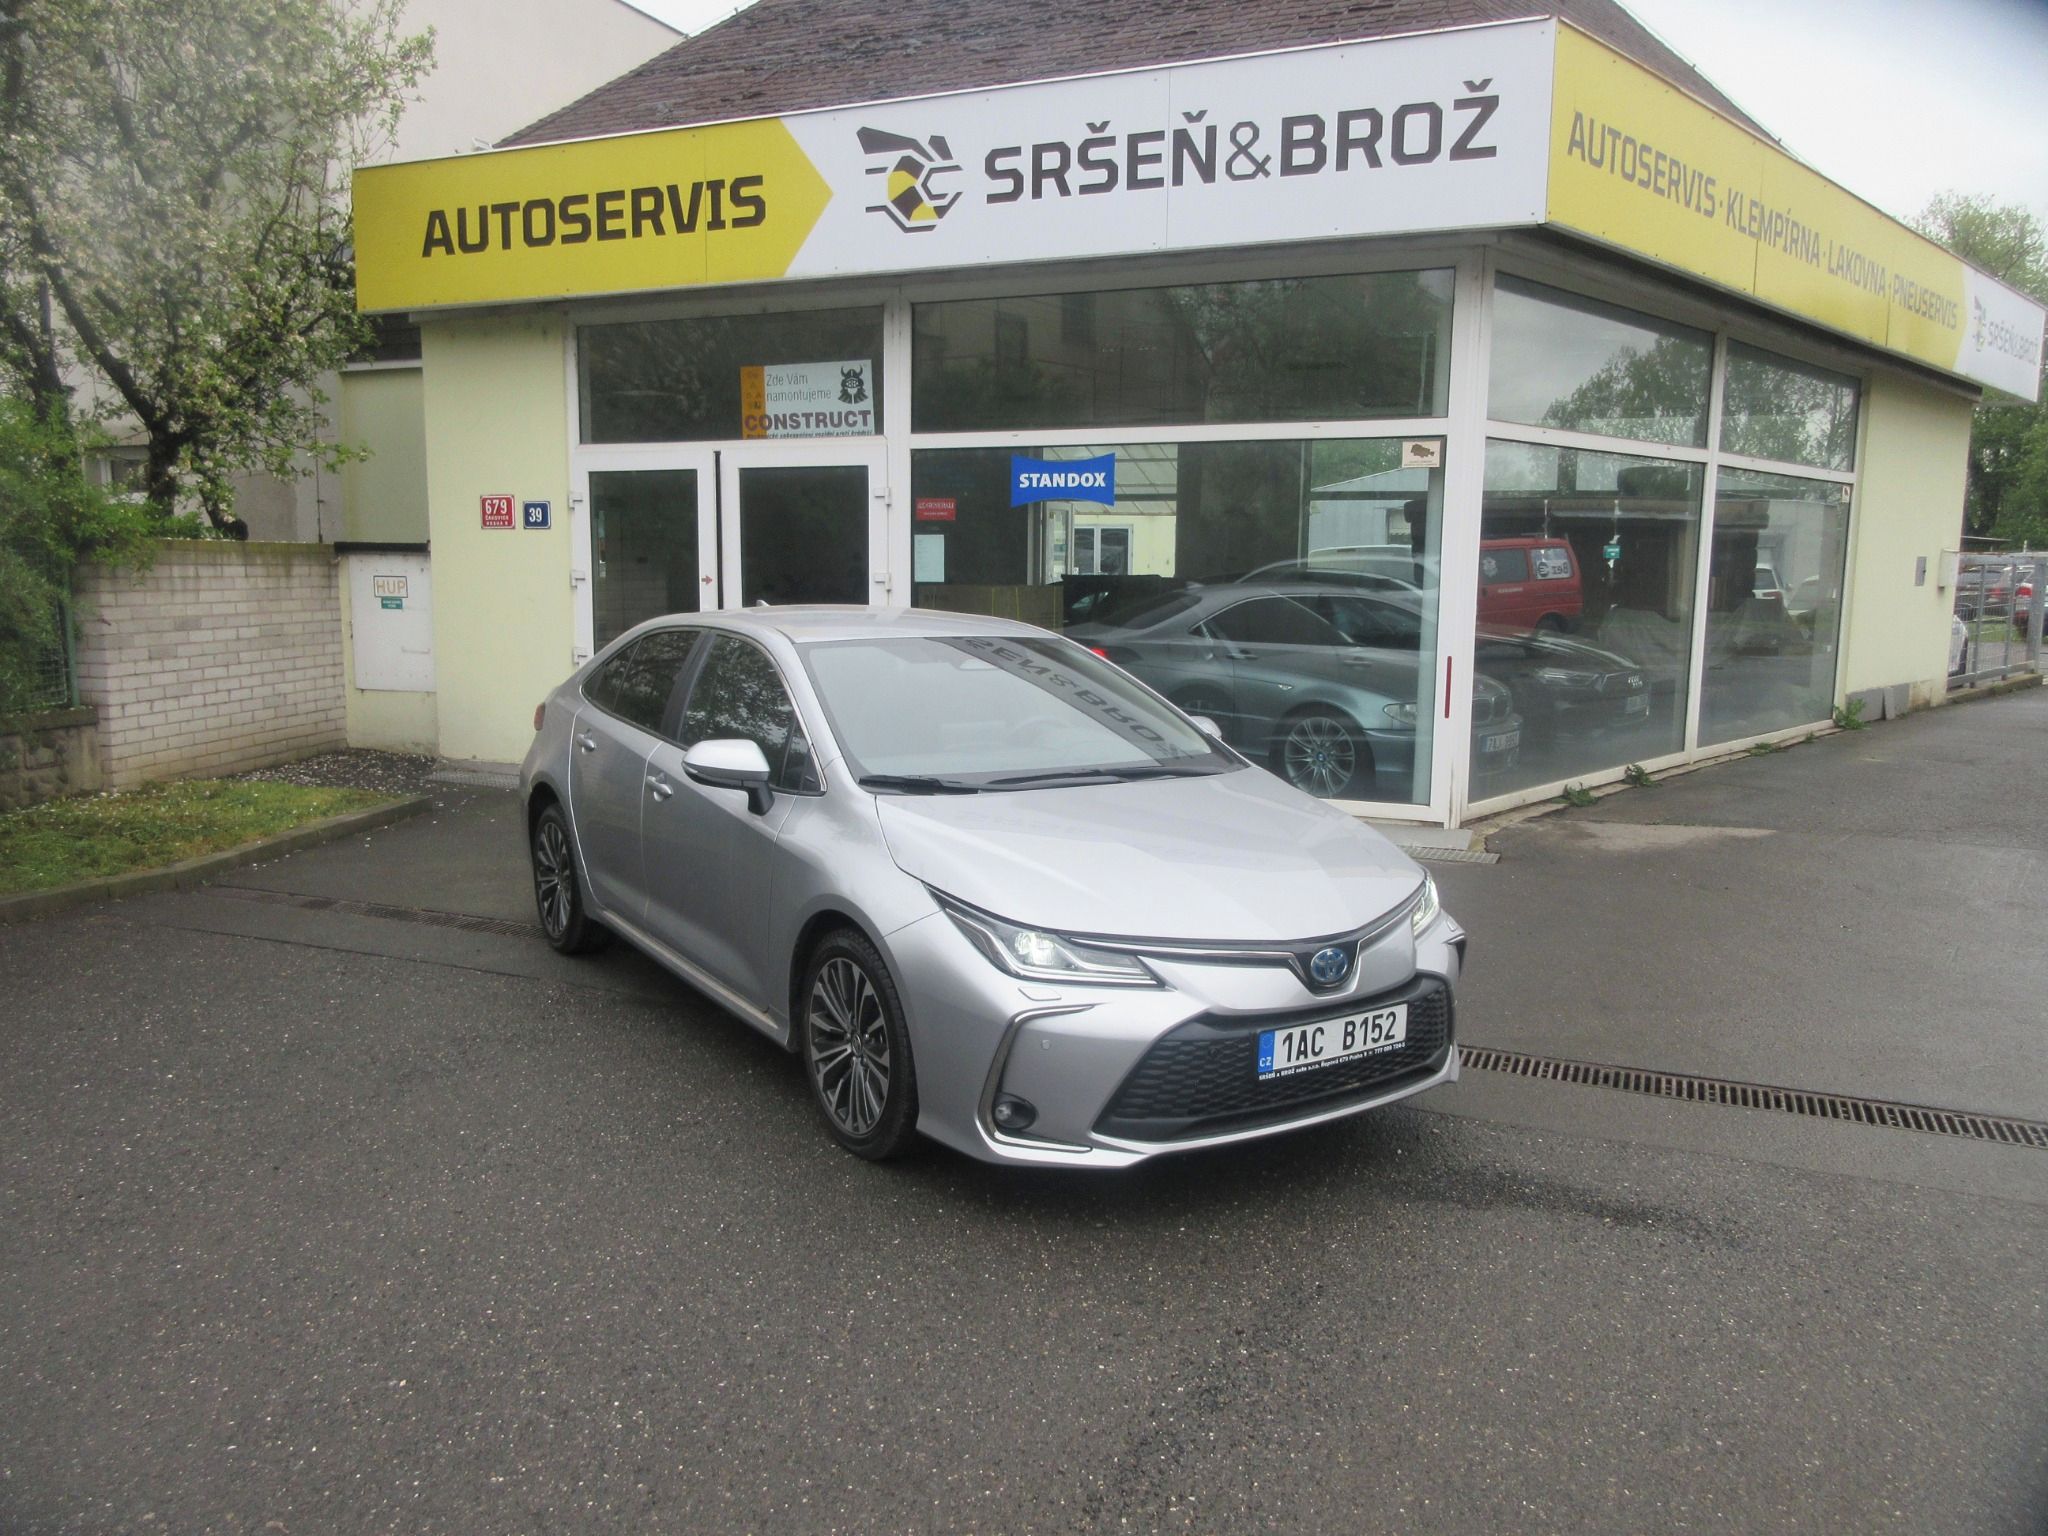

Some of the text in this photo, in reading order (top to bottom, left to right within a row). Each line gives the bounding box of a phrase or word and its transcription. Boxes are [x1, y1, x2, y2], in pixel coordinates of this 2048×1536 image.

[984, 77, 1500, 204] SRŠEŇ&BROŽ
[421, 174, 766, 258] AUTOSERVIS
[1567, 111, 1959, 331] AUTOSERVIS KLEMPÍRNA LAKOVNA PNEUSERVIS
[766, 372, 808, 387] Zde Vám
[766, 388, 832, 403] namontujeme
[744, 409, 872, 432] CONSTRUCT
[1019, 472, 1106, 488] STANDOX
[485, 499, 508, 515] 679
[529, 507, 542, 522] 39
[376, 580, 406, 594] HUP
[1282, 1011, 1397, 1062] 1AC B152
[1259, 1056, 1272, 1067] CZ
